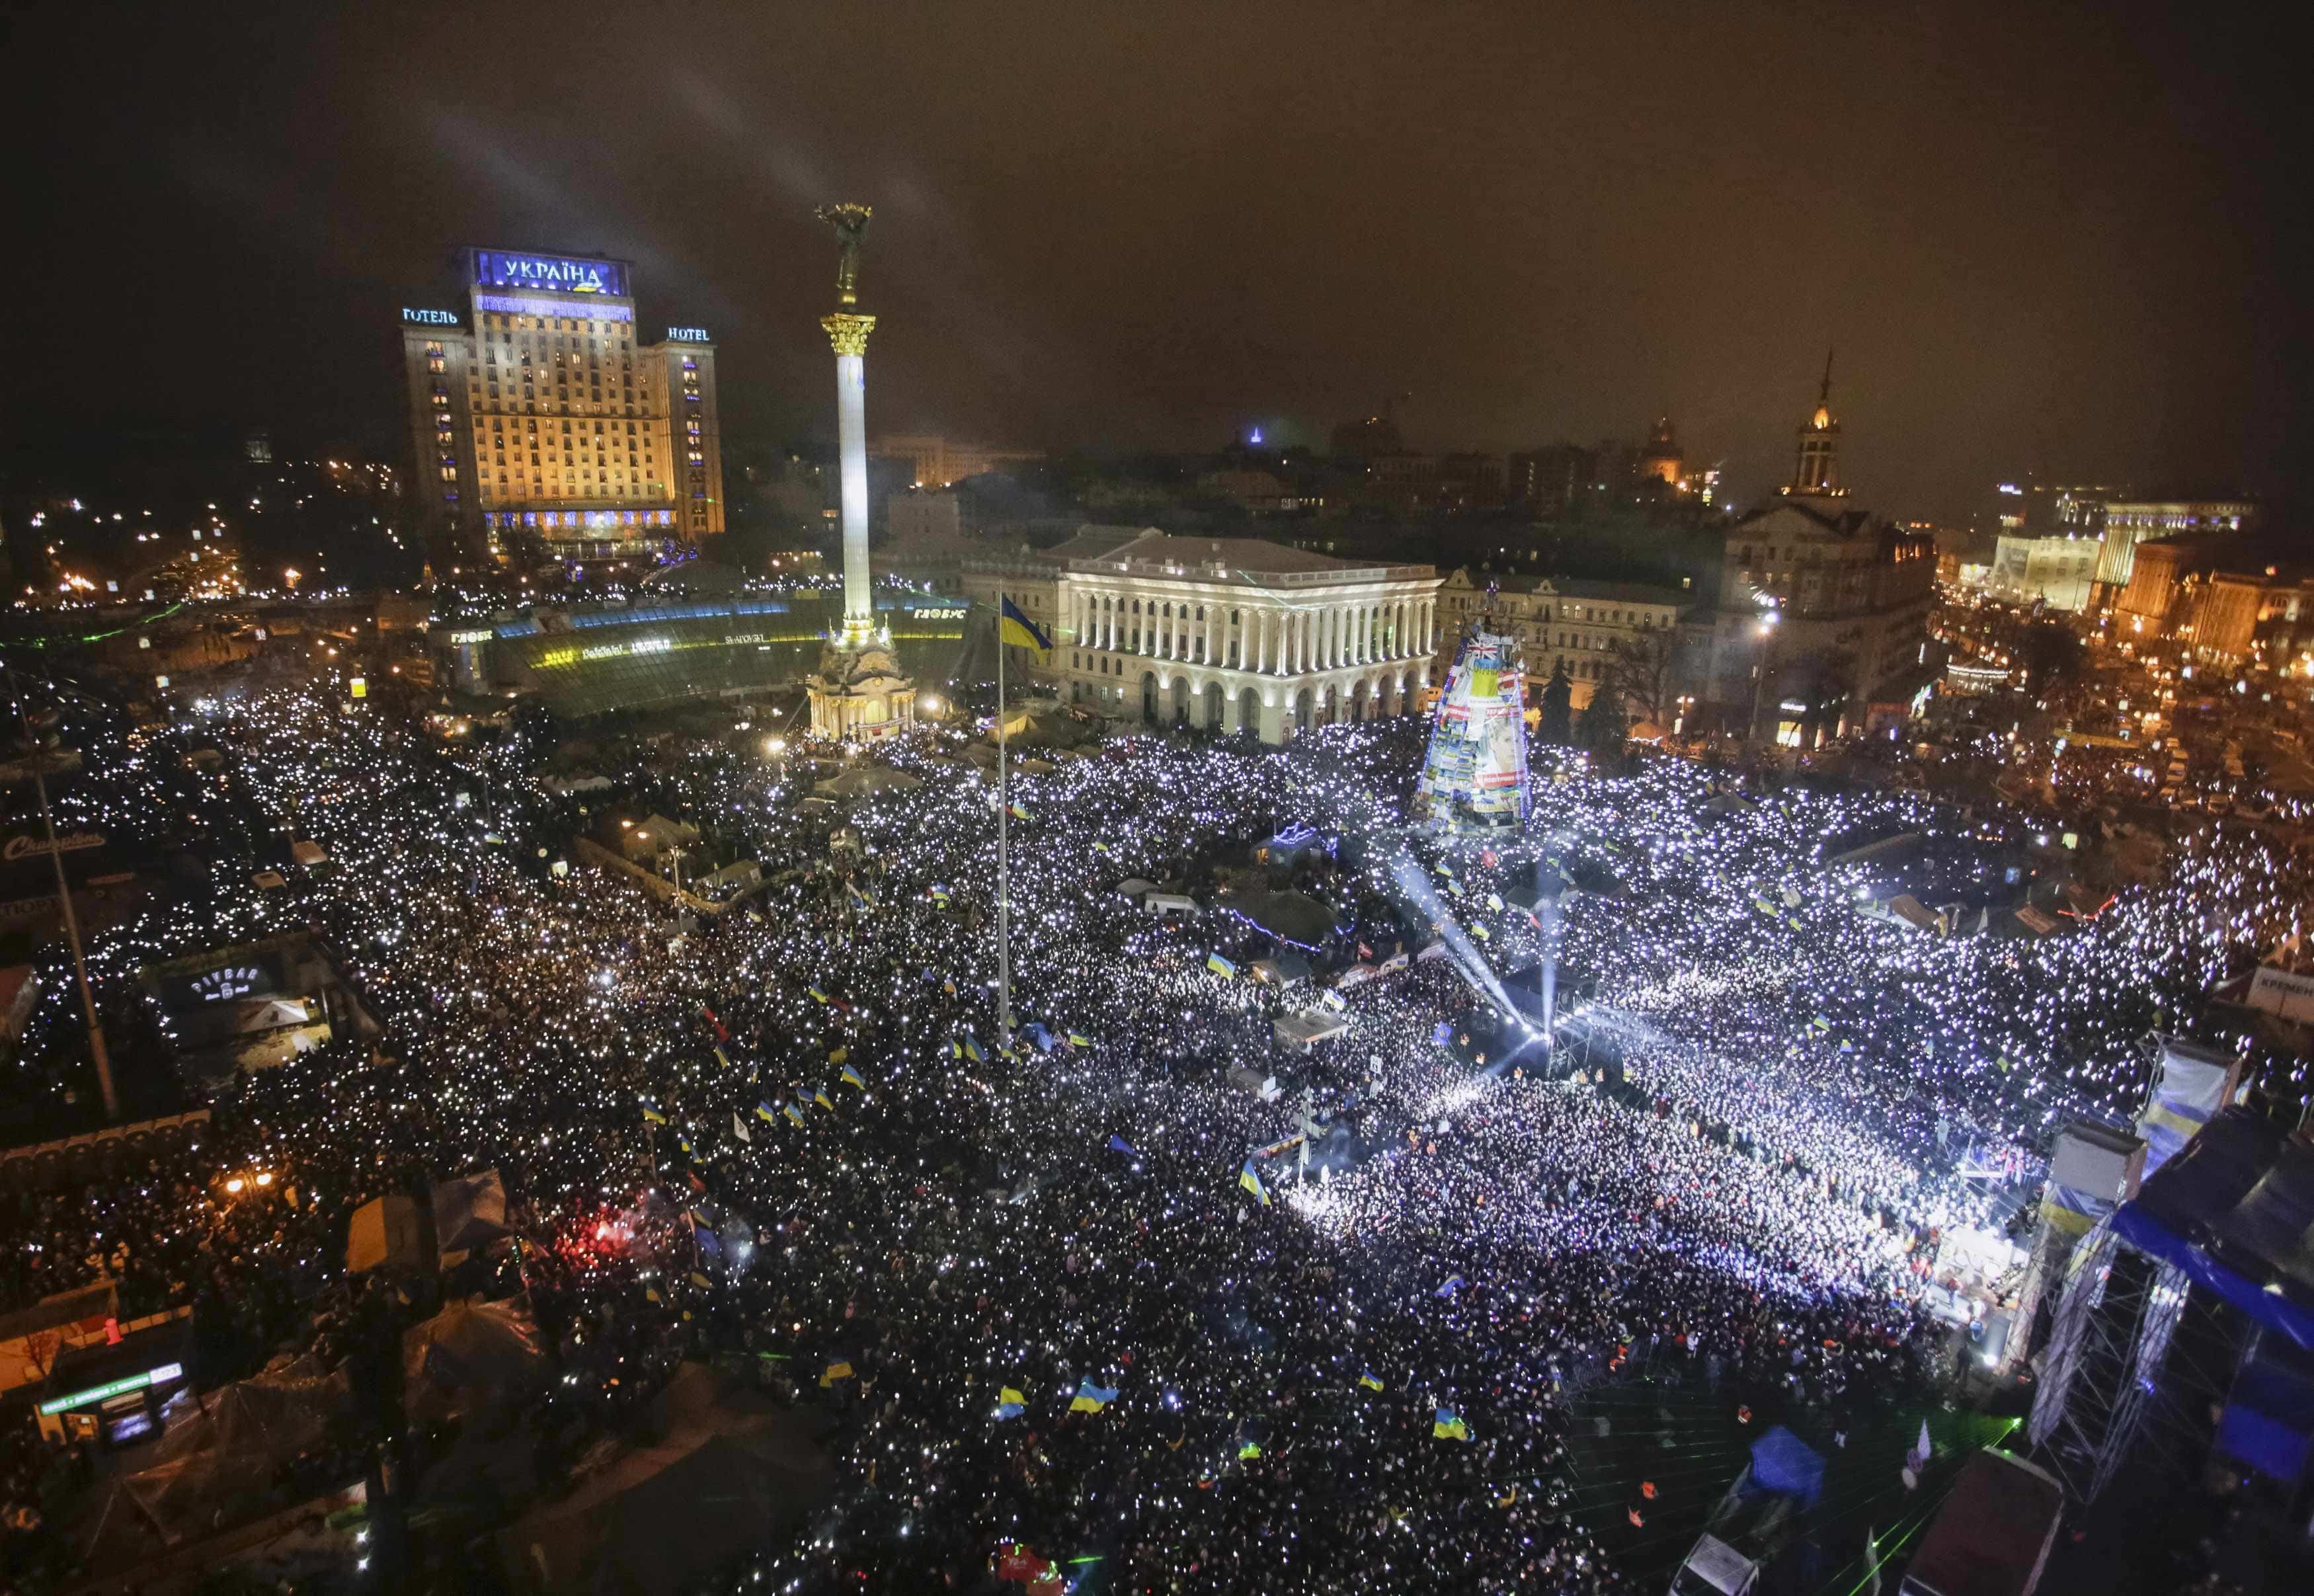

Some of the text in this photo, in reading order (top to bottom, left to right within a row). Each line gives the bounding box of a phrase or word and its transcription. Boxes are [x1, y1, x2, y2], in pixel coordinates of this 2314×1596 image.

[505, 260, 601, 284] УКРАЇНА
[402, 308, 458, 324] ГОТЕЛЬ
[668, 327, 710, 341] HOTEL
[914, 608, 967, 619] ГЛОБУС
